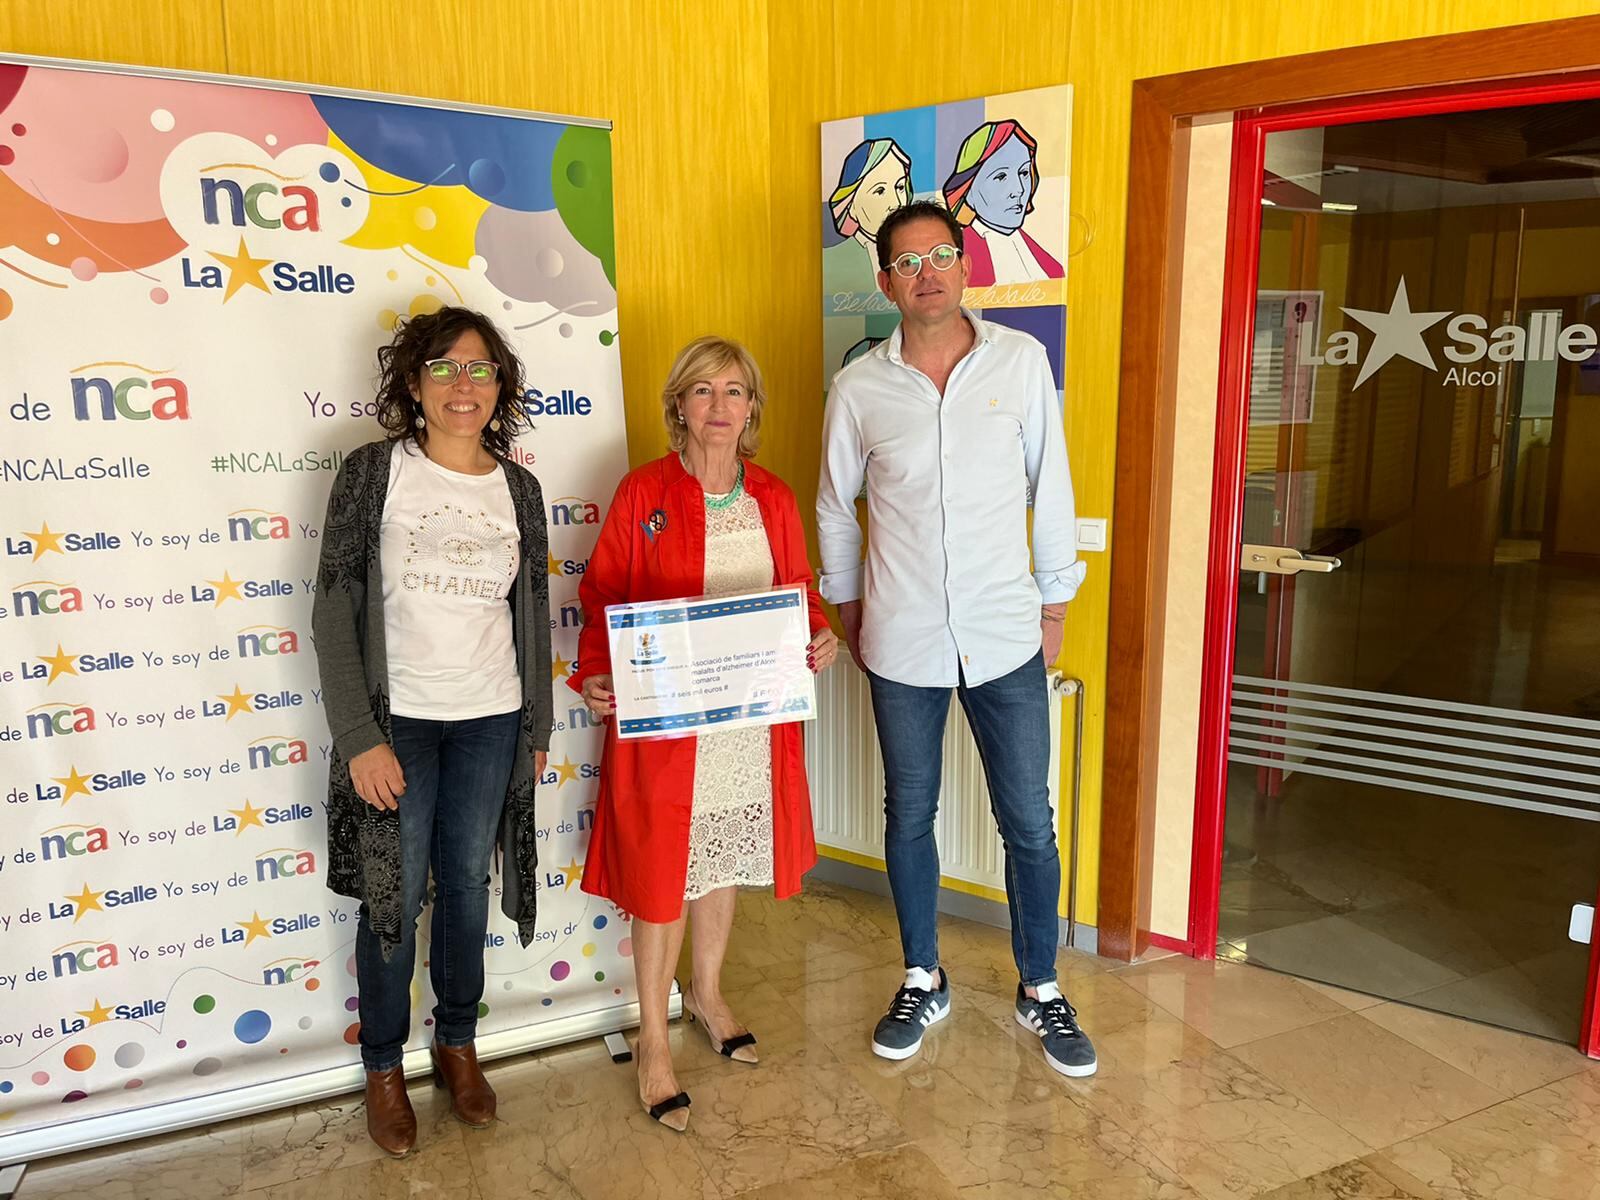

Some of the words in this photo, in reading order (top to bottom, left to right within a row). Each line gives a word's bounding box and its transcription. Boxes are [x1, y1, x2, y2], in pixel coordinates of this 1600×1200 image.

[200, 177, 321, 232] nca
[182, 258, 223, 289] La
[273, 262, 355, 294] Salle
[1299, 321, 1359, 366] La
[1443, 313, 1598, 364] Salle
[1442, 367, 1502, 387] Alcoi
[10, 393, 51, 421] de
[71, 377, 190, 421] nca
[304, 391, 336, 417] Yo
[350, 401, 378, 417] so
[524, 389, 592, 416] Salle
[0, 457, 150, 482] NCALaSalle
[211, 451, 343, 473] #NCALaSall
[552, 503, 599, 525] nca
[6, 537, 33, 556] La
[65, 533, 121, 551] Salle
[131, 531, 153, 547] Yo
[161, 533, 190, 549] soy
[199, 528, 220, 543] de
[228, 515, 290, 541] nca
[299, 523, 318, 539] Yo
[12, 587, 84, 617] nca
[93, 594, 116, 612] Yo
[124, 596, 154, 612] soy
[162, 590, 185, 605] de
[191, 585, 215, 602] La
[243, 580, 294, 599] Salle
[401, 570, 505, 600] CHANEL
[0, 668, 14, 682] e
[22, 662, 47, 680] La
[79, 653, 134, 673] Salle
[142, 652, 164, 667] Yo
[172, 652, 201, 669] soy
[209, 646, 230, 661] de
[237, 630, 298, 658] nca
[723, 655, 732, 663] de
[692, 675, 721, 685] comarca
[704, 685, 723, 694] euros
[0, 725, 22, 742] de
[26, 707, 96, 739] nca
[106, 712, 128, 728] Yo
[136, 711, 165, 728] soy
[173, 706, 196, 721] de
[203, 700, 226, 718] La
[254, 691, 303, 710] Salle
[568, 707, 602, 729] nc
[6, 787, 29, 804] de
[36, 783, 61, 800] La
[92, 770, 147, 792] Salle
[154, 766, 175, 783] Yo
[183, 766, 211, 782] soy
[219, 760, 241, 775] de
[248, 740, 309, 770] nca
[14, 849, 36, 865] de
[40, 827, 109, 861] nca
[119, 830, 140, 846] Yo
[148, 829, 177, 846] soy
[185, 822, 207, 837] de
[213, 815, 237, 833] La
[264, 803, 313, 825] Salle
[536, 827, 551, 841] oy
[556, 820, 574, 834] de
[19, 908, 42, 925] de
[49, 902, 74, 920] La
[104, 886, 157, 908] Salle
[163, 882, 183, 898] Yo
[192, 880, 219, 896] soy
[227, 872, 248, 888] de
[256, 851, 316, 882] nca
[546, 873, 564, 888] La
[25, 966, 48, 983] de
[52, 943, 120, 978] nca
[129, 945, 150, 962] Yo
[157, 941, 186, 958] soy
[193, 934, 215, 950] de
[221, 927, 244, 945] La
[272, 913, 321, 935] Salle
[329, 908, 347, 924] Yo
[486, 933, 504, 948] lle
[535, 929, 558, 943] soy
[32, 1023, 54, 1039] de
[61, 1018, 85, 1035] La
[115, 999, 167, 1020] Salle
